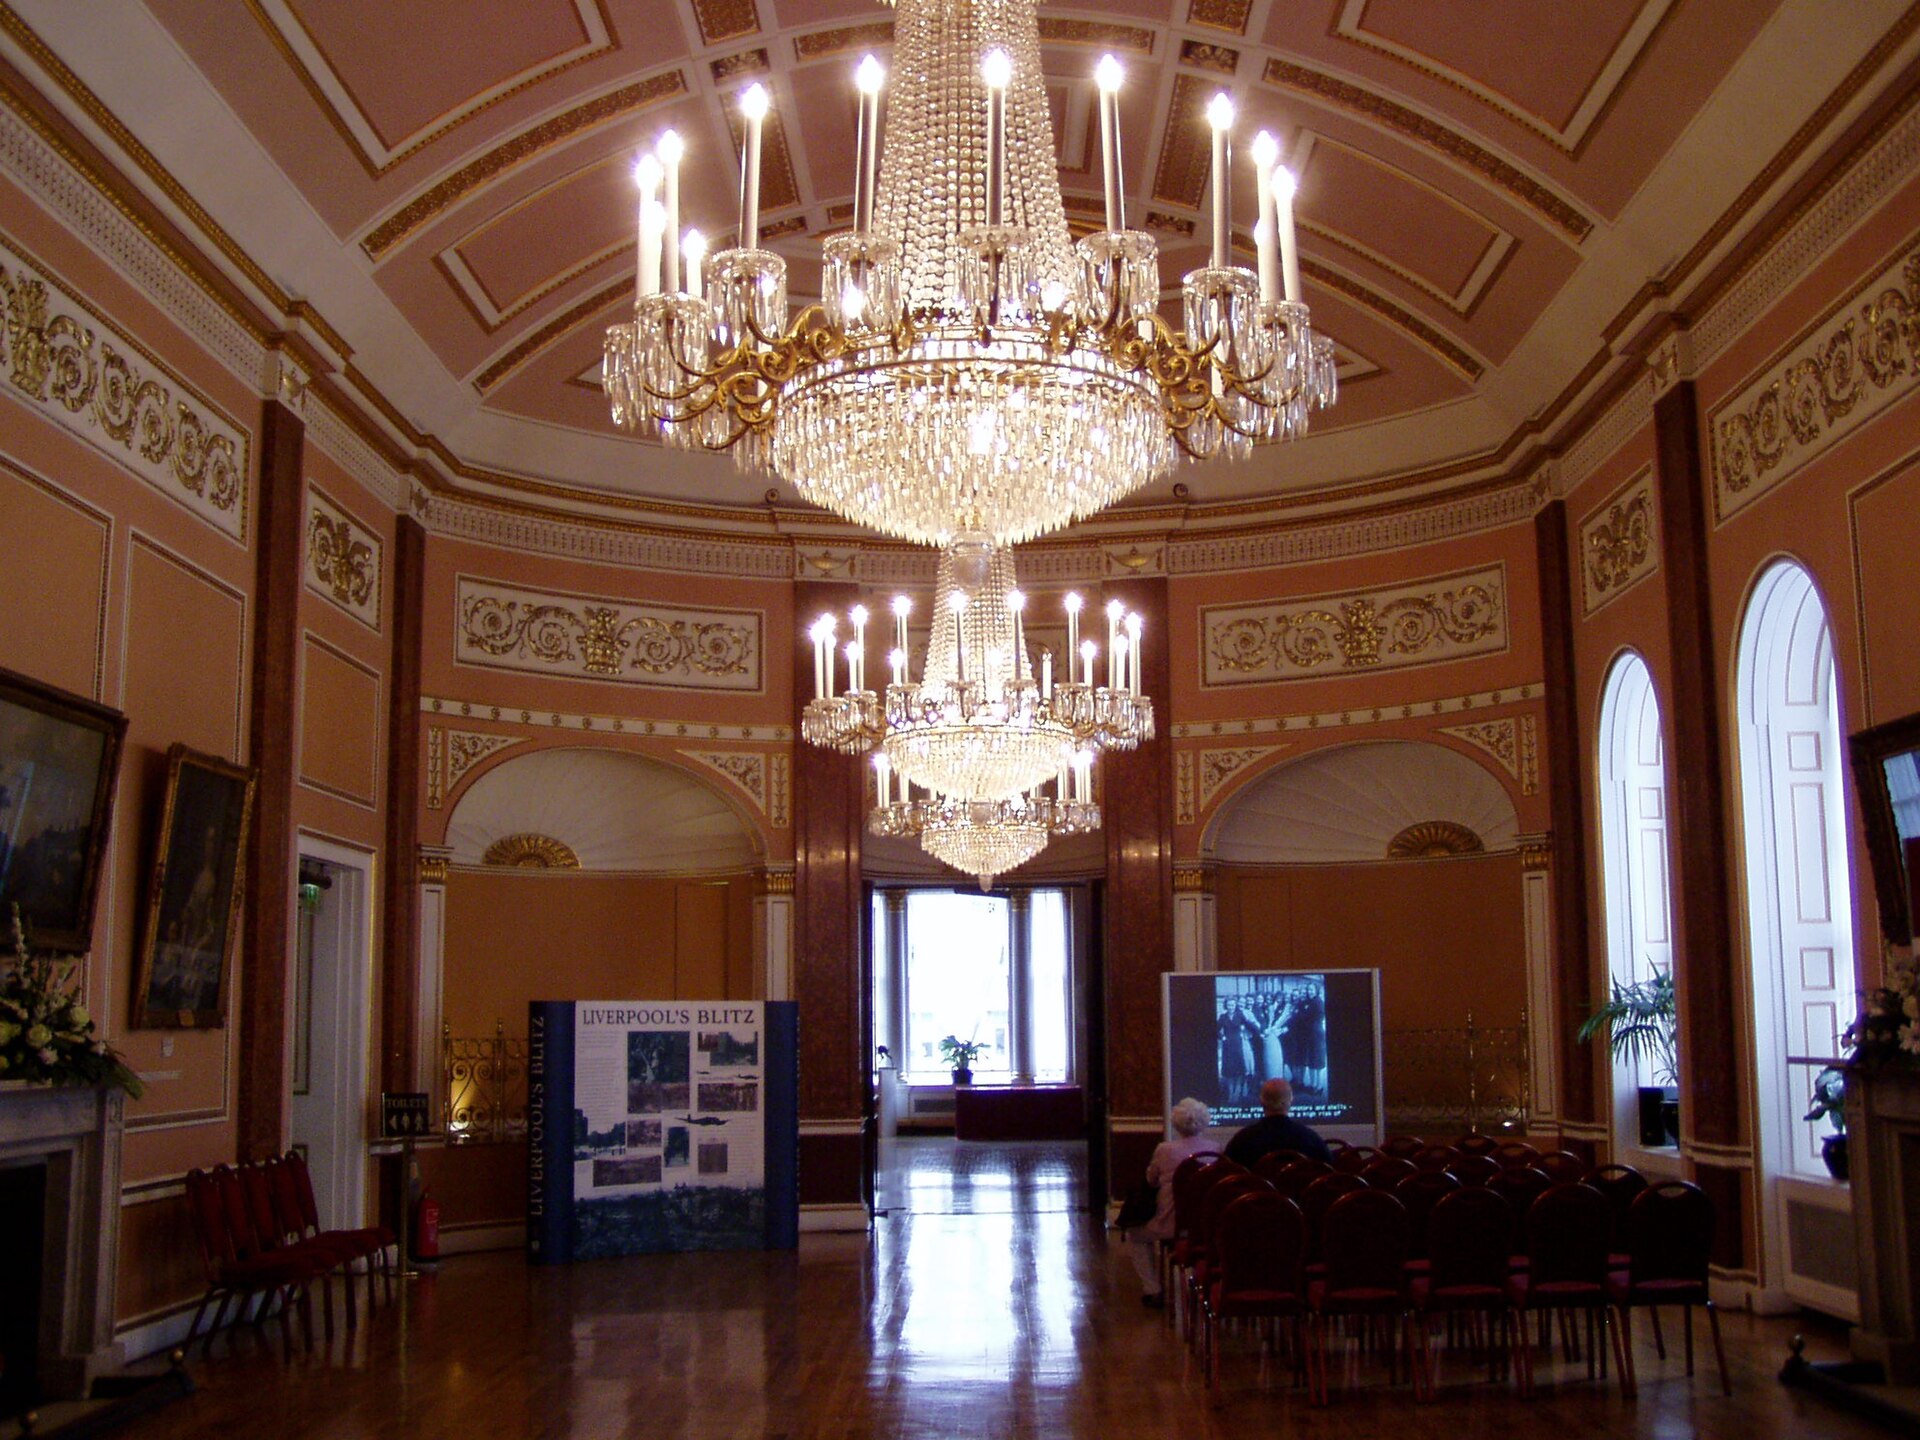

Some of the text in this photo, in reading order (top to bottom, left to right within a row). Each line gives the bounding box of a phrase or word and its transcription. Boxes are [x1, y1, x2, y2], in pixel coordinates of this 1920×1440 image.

[583, 1009, 755, 1025] LIVERPOOL'S BLITZ
[531, 1015, 545, 1216] LIVERPOOL'S BLITZ
